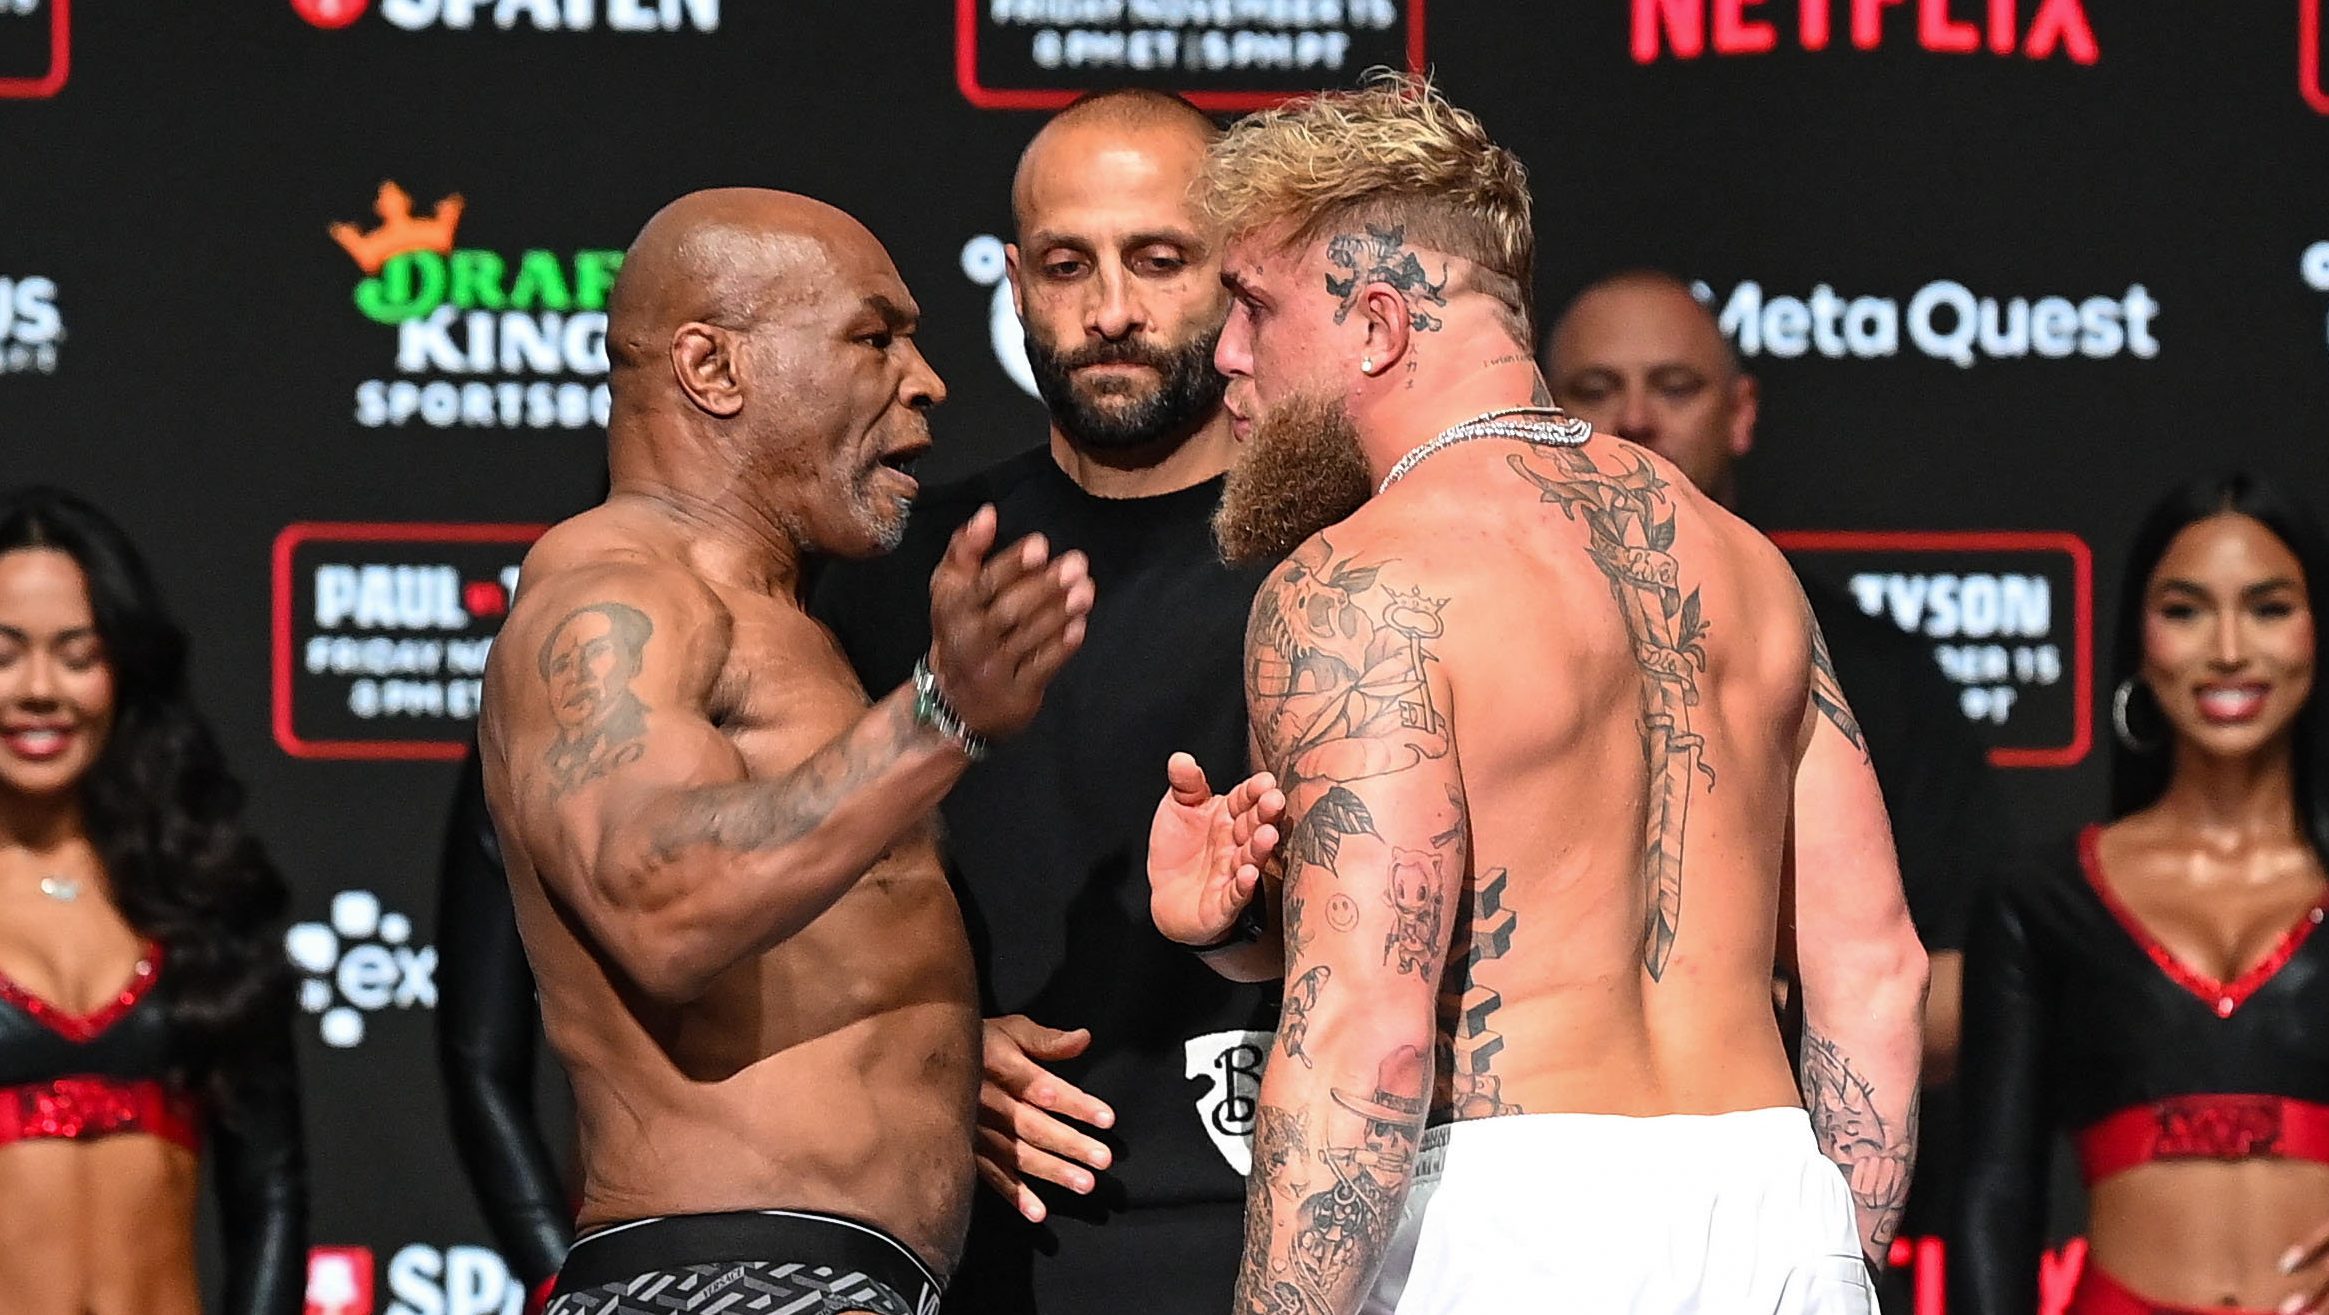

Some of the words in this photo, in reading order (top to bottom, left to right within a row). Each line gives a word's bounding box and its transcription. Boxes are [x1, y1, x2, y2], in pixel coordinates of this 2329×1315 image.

[354, 249, 626, 324] DRAF
[397, 303, 610, 375] KING
[1907, 279, 2160, 369] Quest
[314, 562, 469, 630] PAUL
[1848, 572, 2051, 639] TYSON
